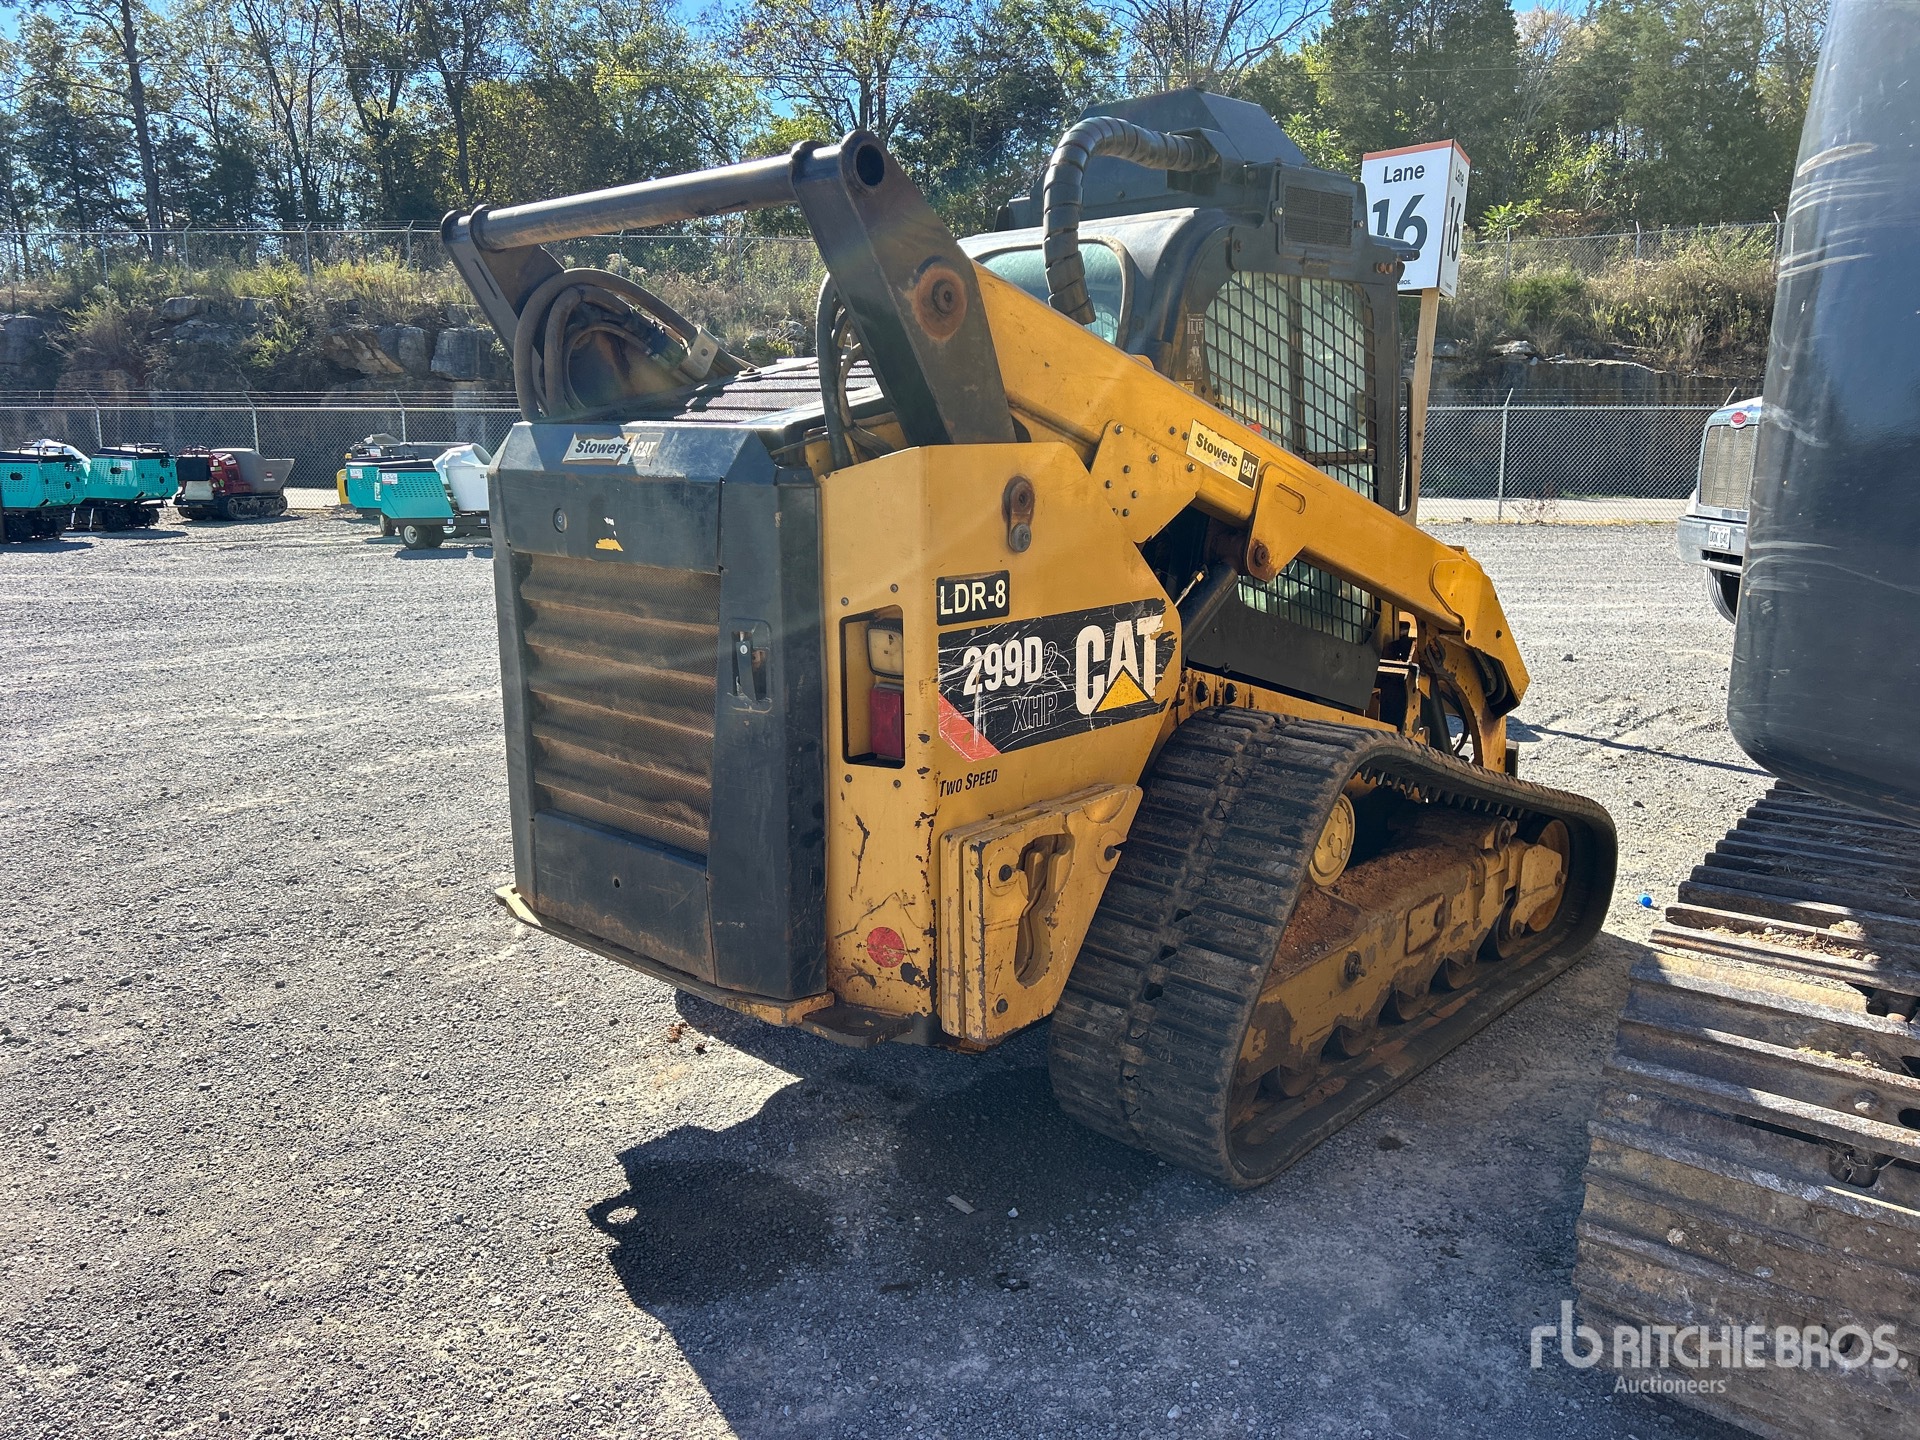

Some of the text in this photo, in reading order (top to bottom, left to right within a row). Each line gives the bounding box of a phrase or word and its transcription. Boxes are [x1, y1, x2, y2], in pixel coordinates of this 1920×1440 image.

[1384, 164, 1425, 184] Lane
[1372, 194, 1428, 252] 16
[1446, 196, 1462, 262] 16
[575, 440, 657, 457] Stowers CAT
[1195, 433, 1257, 479] Stowers CAT
[939, 579, 1007, 616] LDR-8
[1075, 615, 1164, 715] CAT
[1012, 692, 1058, 733] XHP
